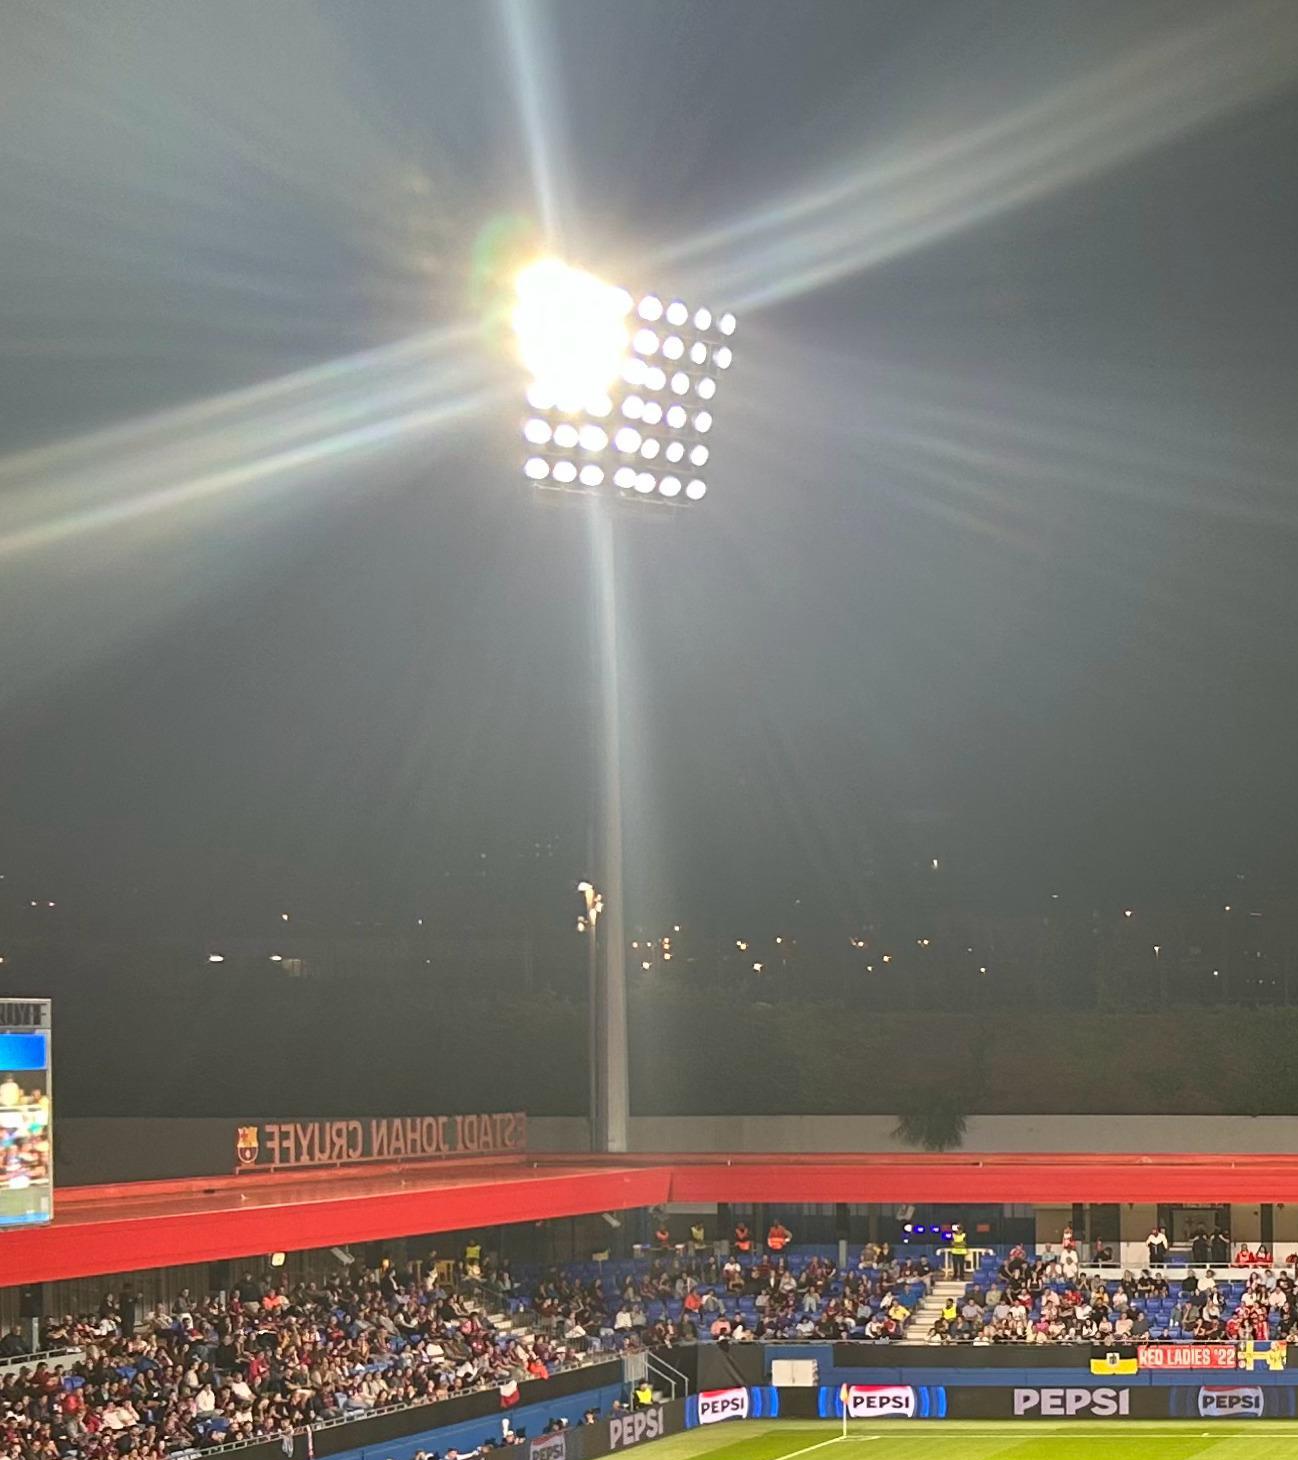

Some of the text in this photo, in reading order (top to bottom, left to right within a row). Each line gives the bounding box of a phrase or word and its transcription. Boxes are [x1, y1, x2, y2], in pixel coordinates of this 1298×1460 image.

[1139, 1348, 1163, 1366] RED
[1167, 1348, 1210, 1366] LADIES
[701, 1397, 744, 1415] PEPSI
[853, 1395, 910, 1409] PEPSI
[1014, 1388, 1129, 1416] PEPSI
[1202, 1395, 1260, 1410] PEPSI
[609, 1407, 664, 1449] PEPSI
